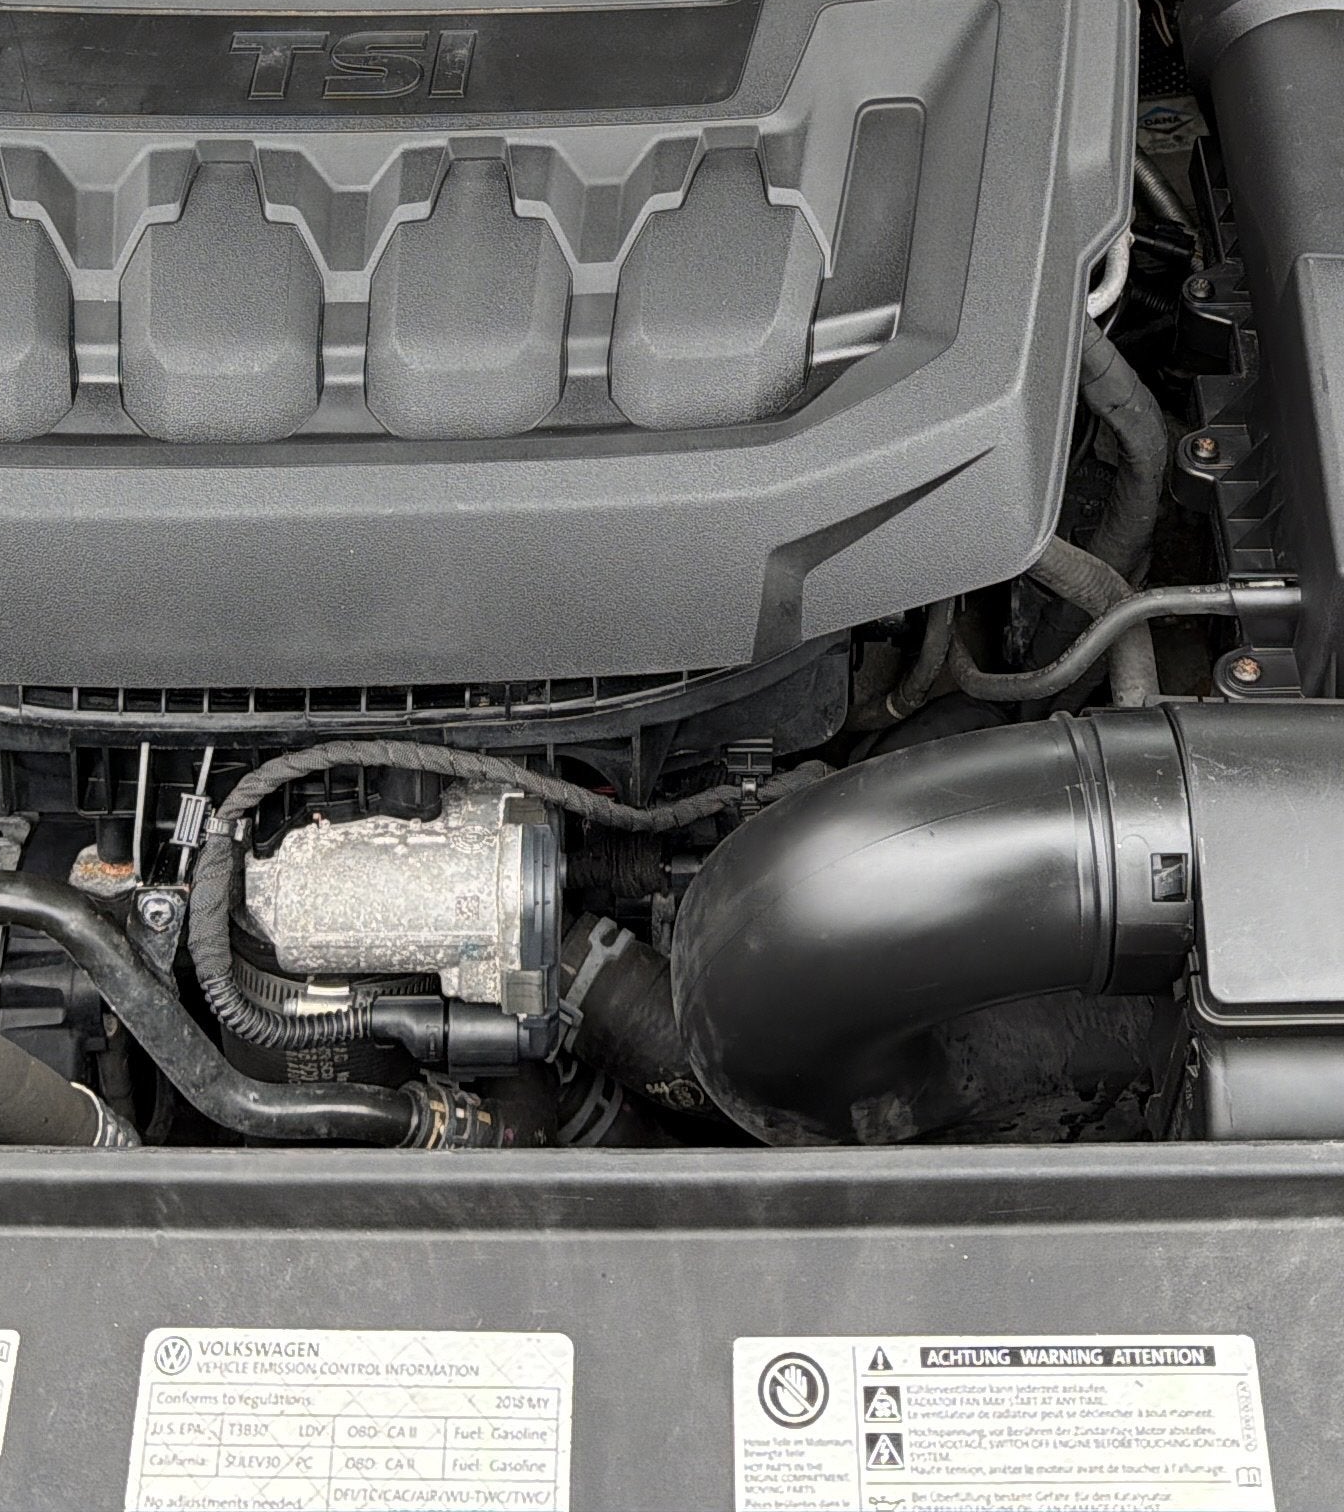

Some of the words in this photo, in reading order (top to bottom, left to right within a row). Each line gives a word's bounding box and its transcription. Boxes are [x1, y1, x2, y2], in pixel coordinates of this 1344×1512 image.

[229, 29, 479, 100] TSI
[198, 1341, 320, 1358] VOLKSWAGEN
[926, 1349, 1011, 1366] ACHTUNG
[1019, 1348, 1104, 1366] WARNING
[1112, 1347, 1205, 1365] ATTENTION
[196, 1361, 249, 1375] VEHICLE
[253, 1361, 317, 1375] EMISSION
[320, 1363, 381, 1376] CONTROL
[386, 1364, 480, 1377] INFORMATION
[156, 1391, 218, 1405] Conforms
[222, 1392, 236, 1405] to
[299, 1424, 326, 1437] LDV
[491, 1426, 548, 1441] Gasoline
[489, 1458, 546, 1472] Gasoline
[144, 1494, 162, 1508] No
[167, 1494, 249, 1510] adjustments
